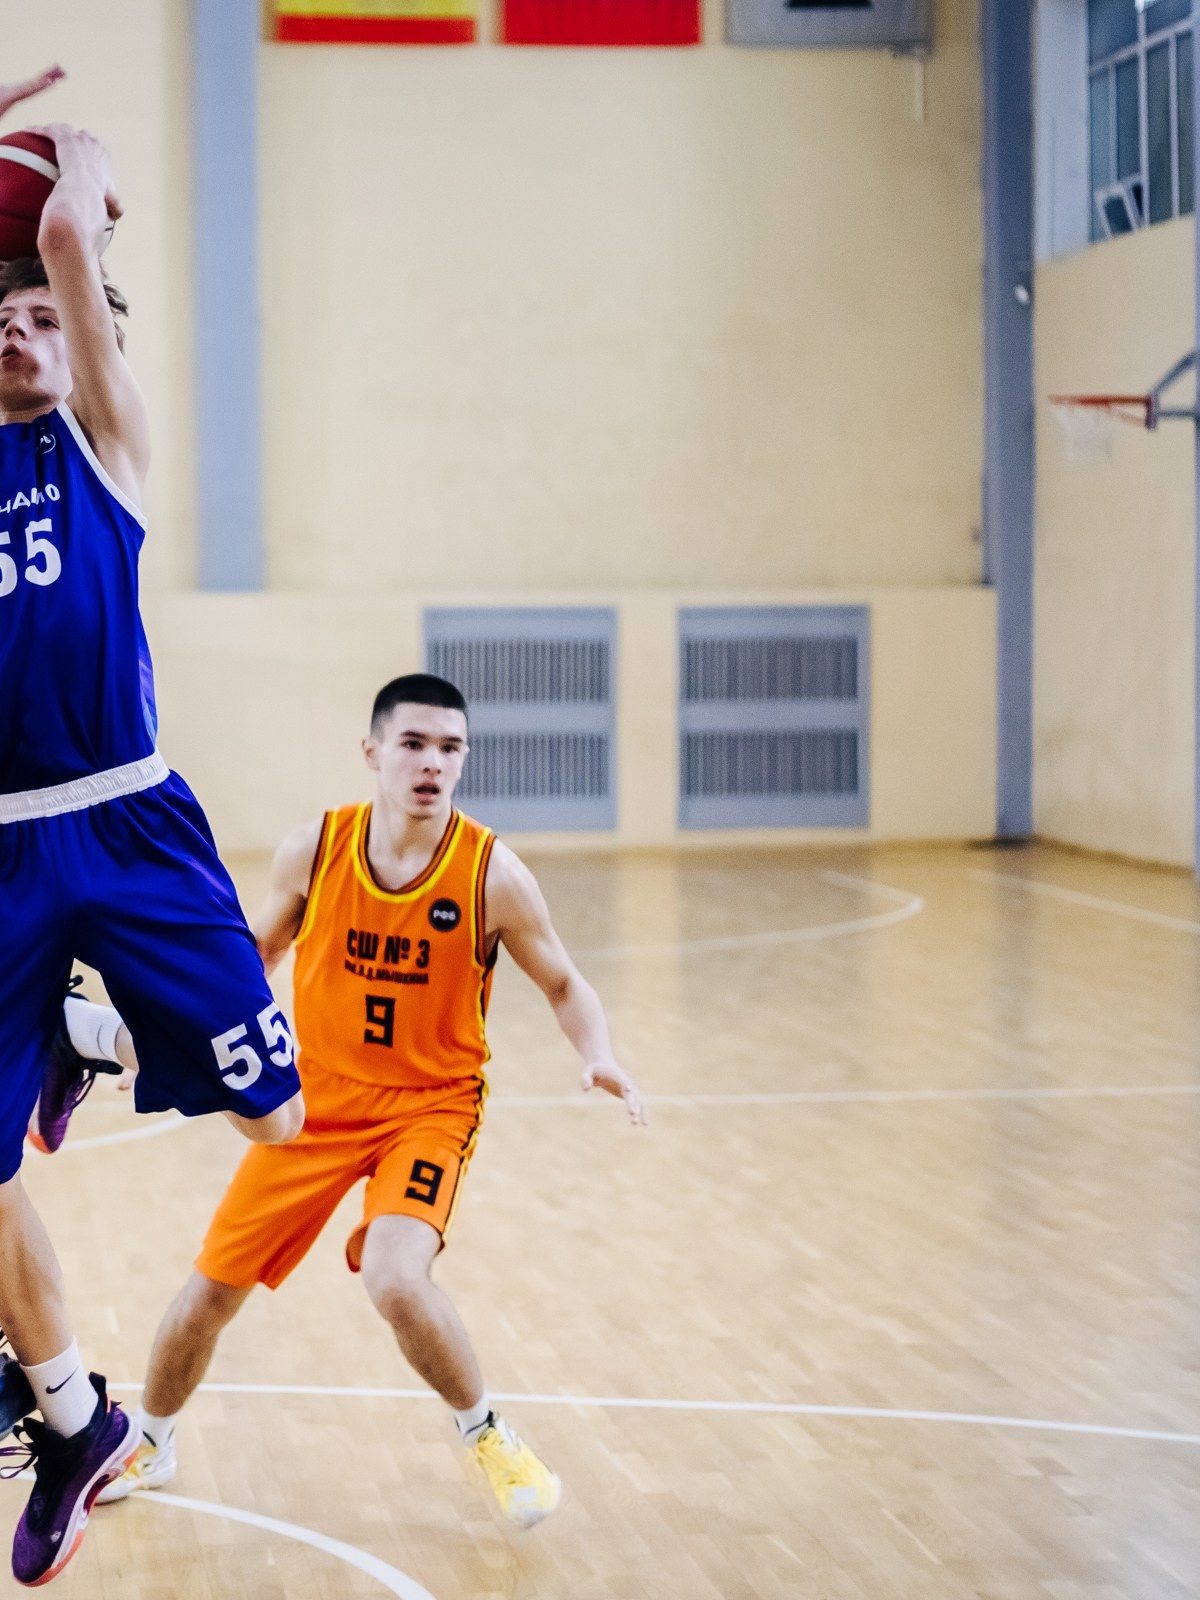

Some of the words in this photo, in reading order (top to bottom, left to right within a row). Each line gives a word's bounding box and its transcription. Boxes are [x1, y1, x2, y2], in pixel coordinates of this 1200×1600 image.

[346, 927, 380, 962] СШ
[415, 938, 432, 969] 3
[210, 1001, 294, 1091] 55
[363, 993, 397, 1049] 9
[403, 1158, 445, 1207] 9
